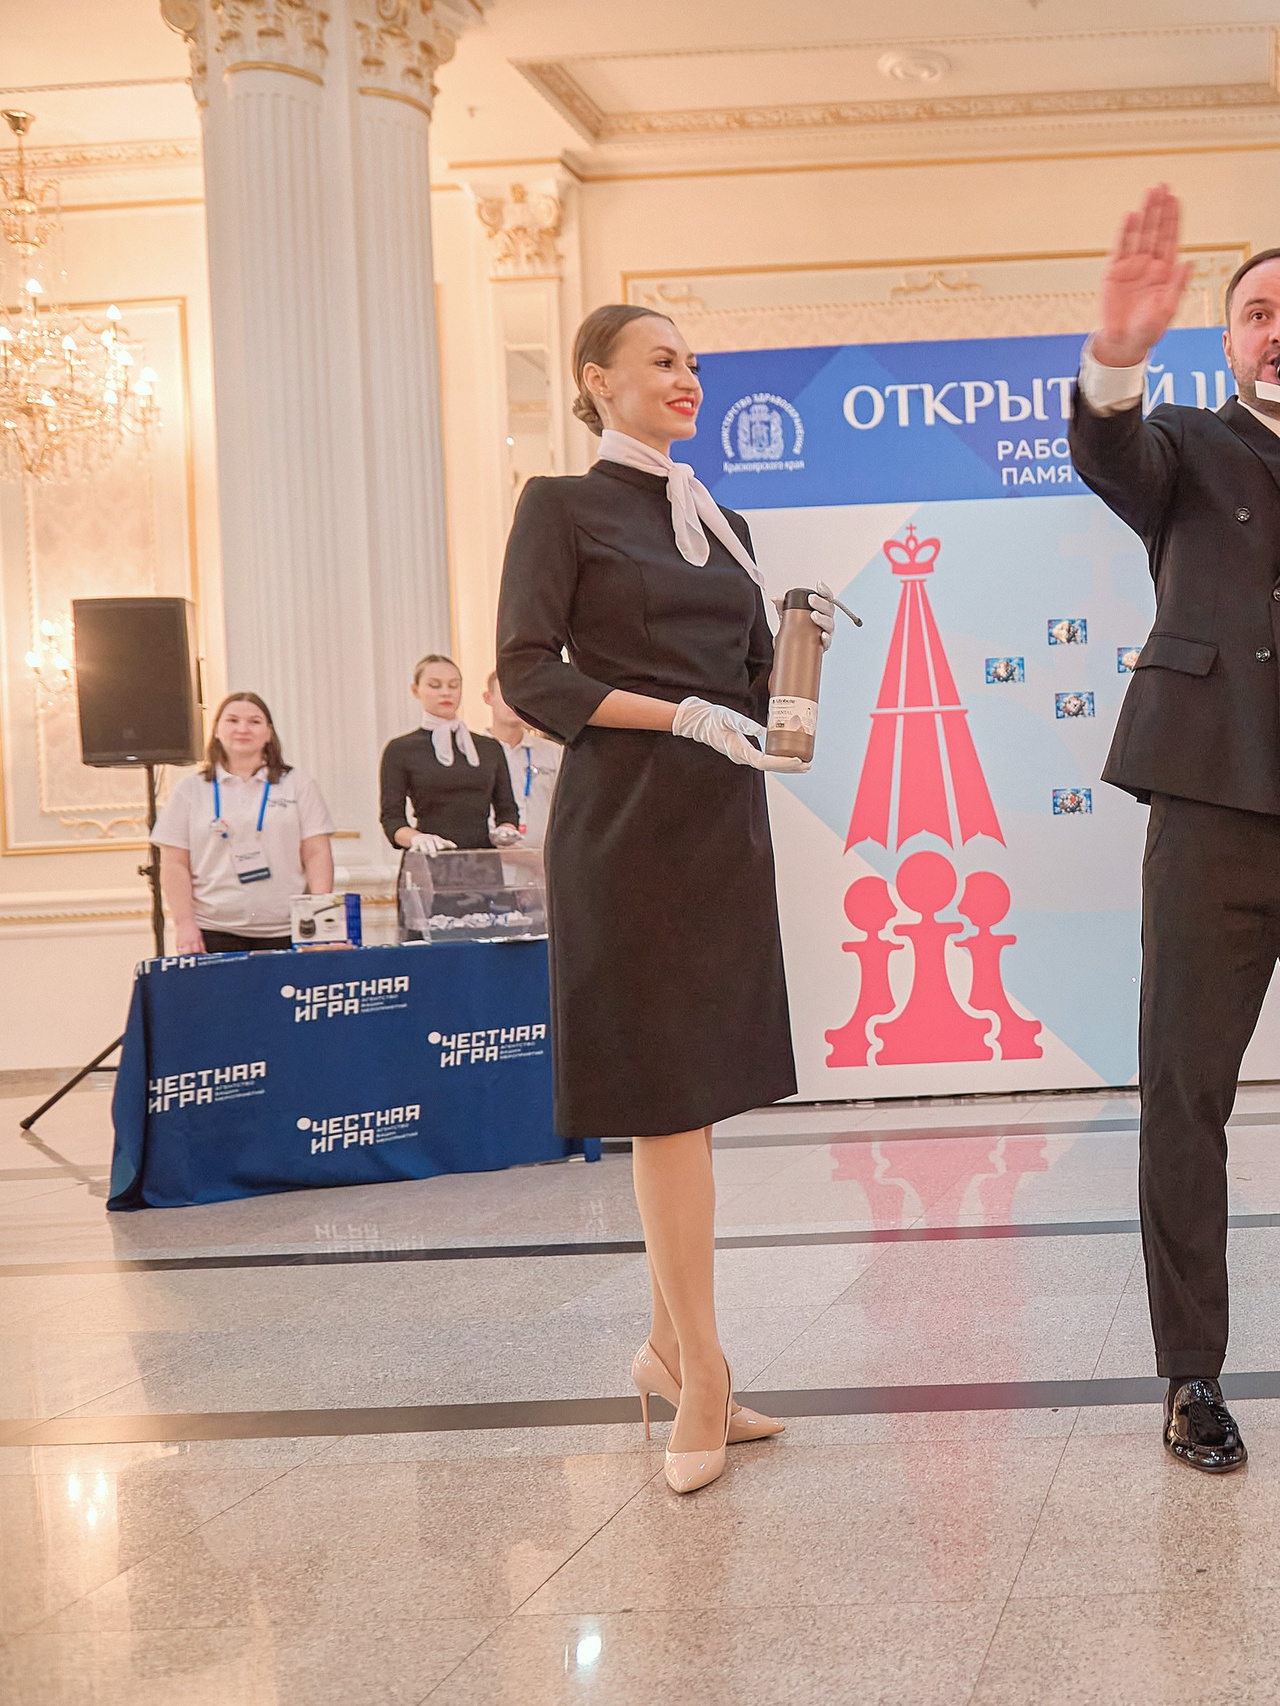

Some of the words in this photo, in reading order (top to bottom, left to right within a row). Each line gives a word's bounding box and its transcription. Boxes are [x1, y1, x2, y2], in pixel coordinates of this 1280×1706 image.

[843, 364, 1175, 430] ОТКРЫТЙ
[997, 438, 1071, 461] РАБО
[1002, 464, 1083, 486] ПАМЯ
[296, 976, 409, 1003] ЧЕСТНАЯ
[295, 998, 359, 1022] ИГРА
[442, 1023, 546, 1050] ЧЕСТНАЯ
[441, 1045, 499, 1068] ИГРА
[148, 1061, 266, 1094] ЧЕСТНАЯ
[148, 1087, 213, 1114] ИГРА
[312, 1104, 420, 1135] ЧЕСТНАЯ
[311, 1128, 374, 1154] ИГРА
